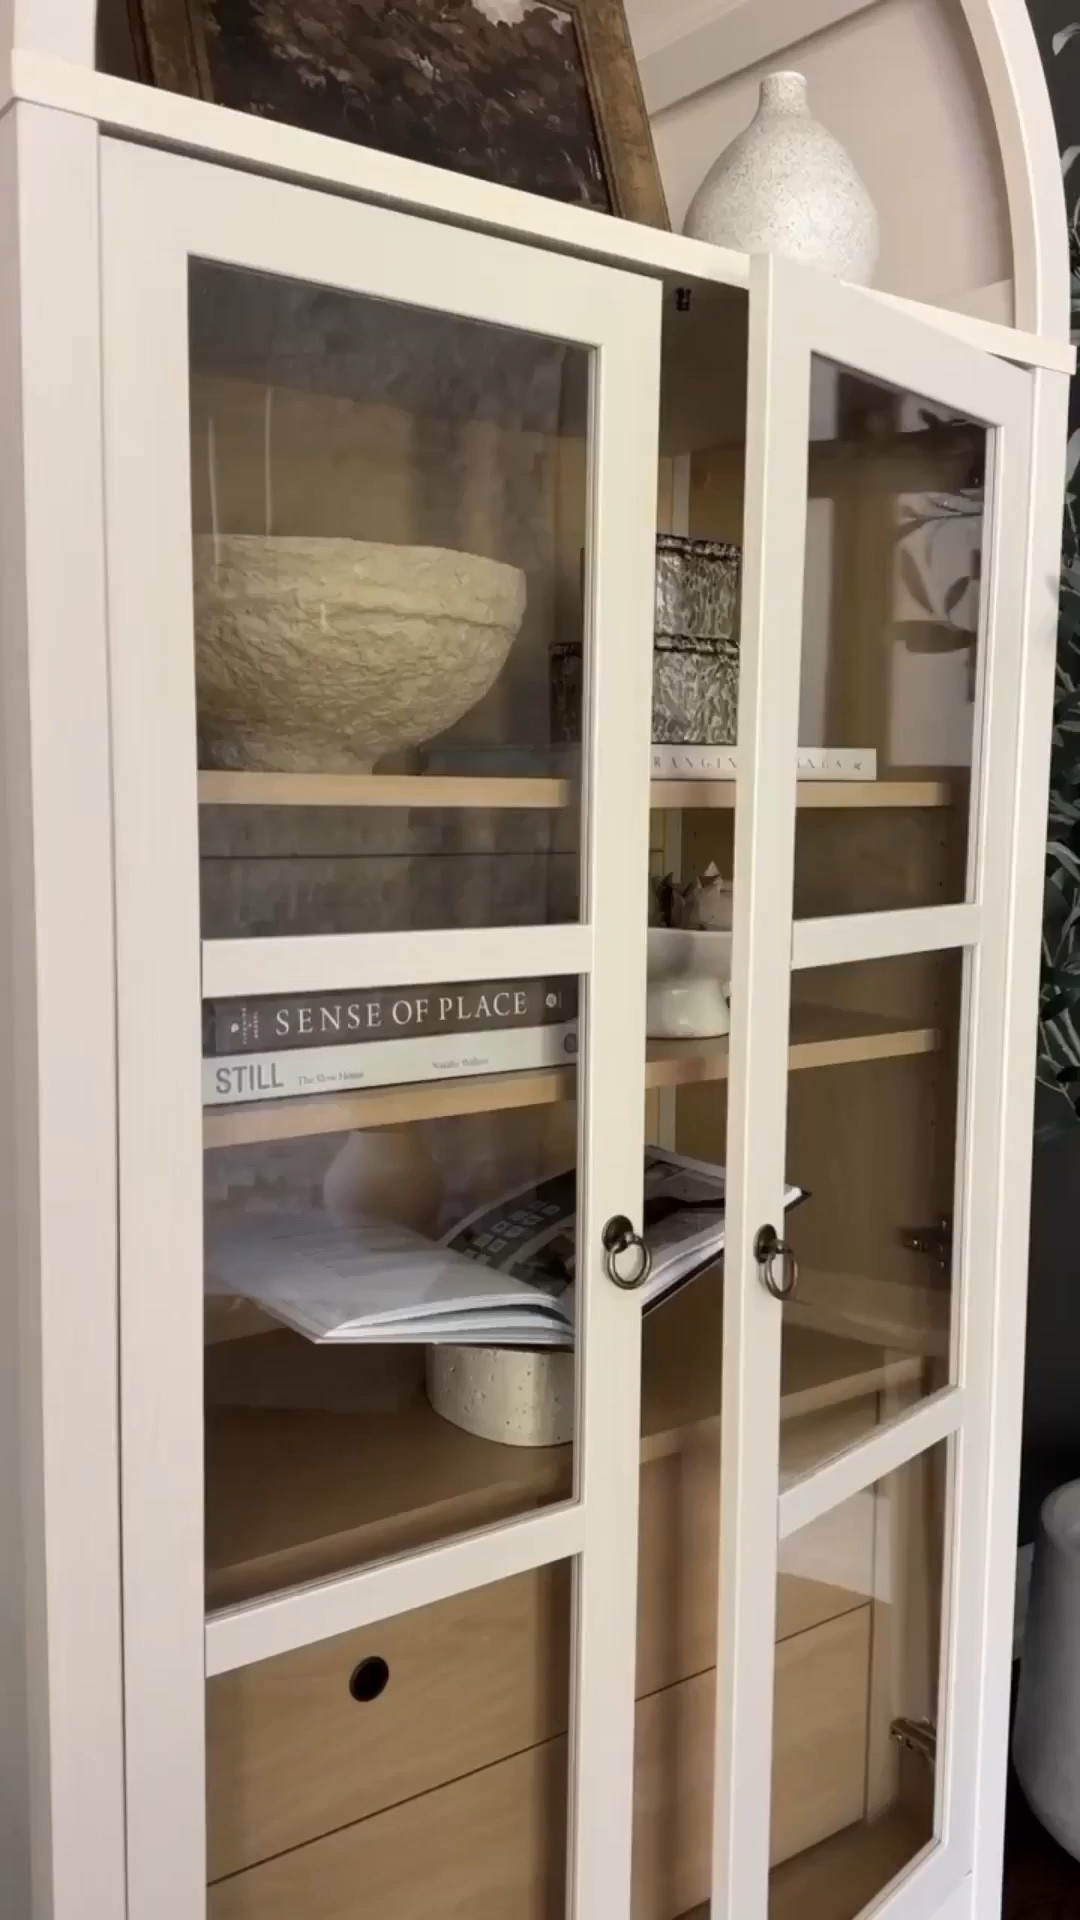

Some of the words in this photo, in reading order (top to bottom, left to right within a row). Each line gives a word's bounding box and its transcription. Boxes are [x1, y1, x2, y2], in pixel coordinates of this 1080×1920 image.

[275, 1002, 383, 1036] SENSE
[391, 998, 429, 1025] OF
[439, 991, 528, 1021] PLACE
[215, 1062, 285, 1095] STILL
